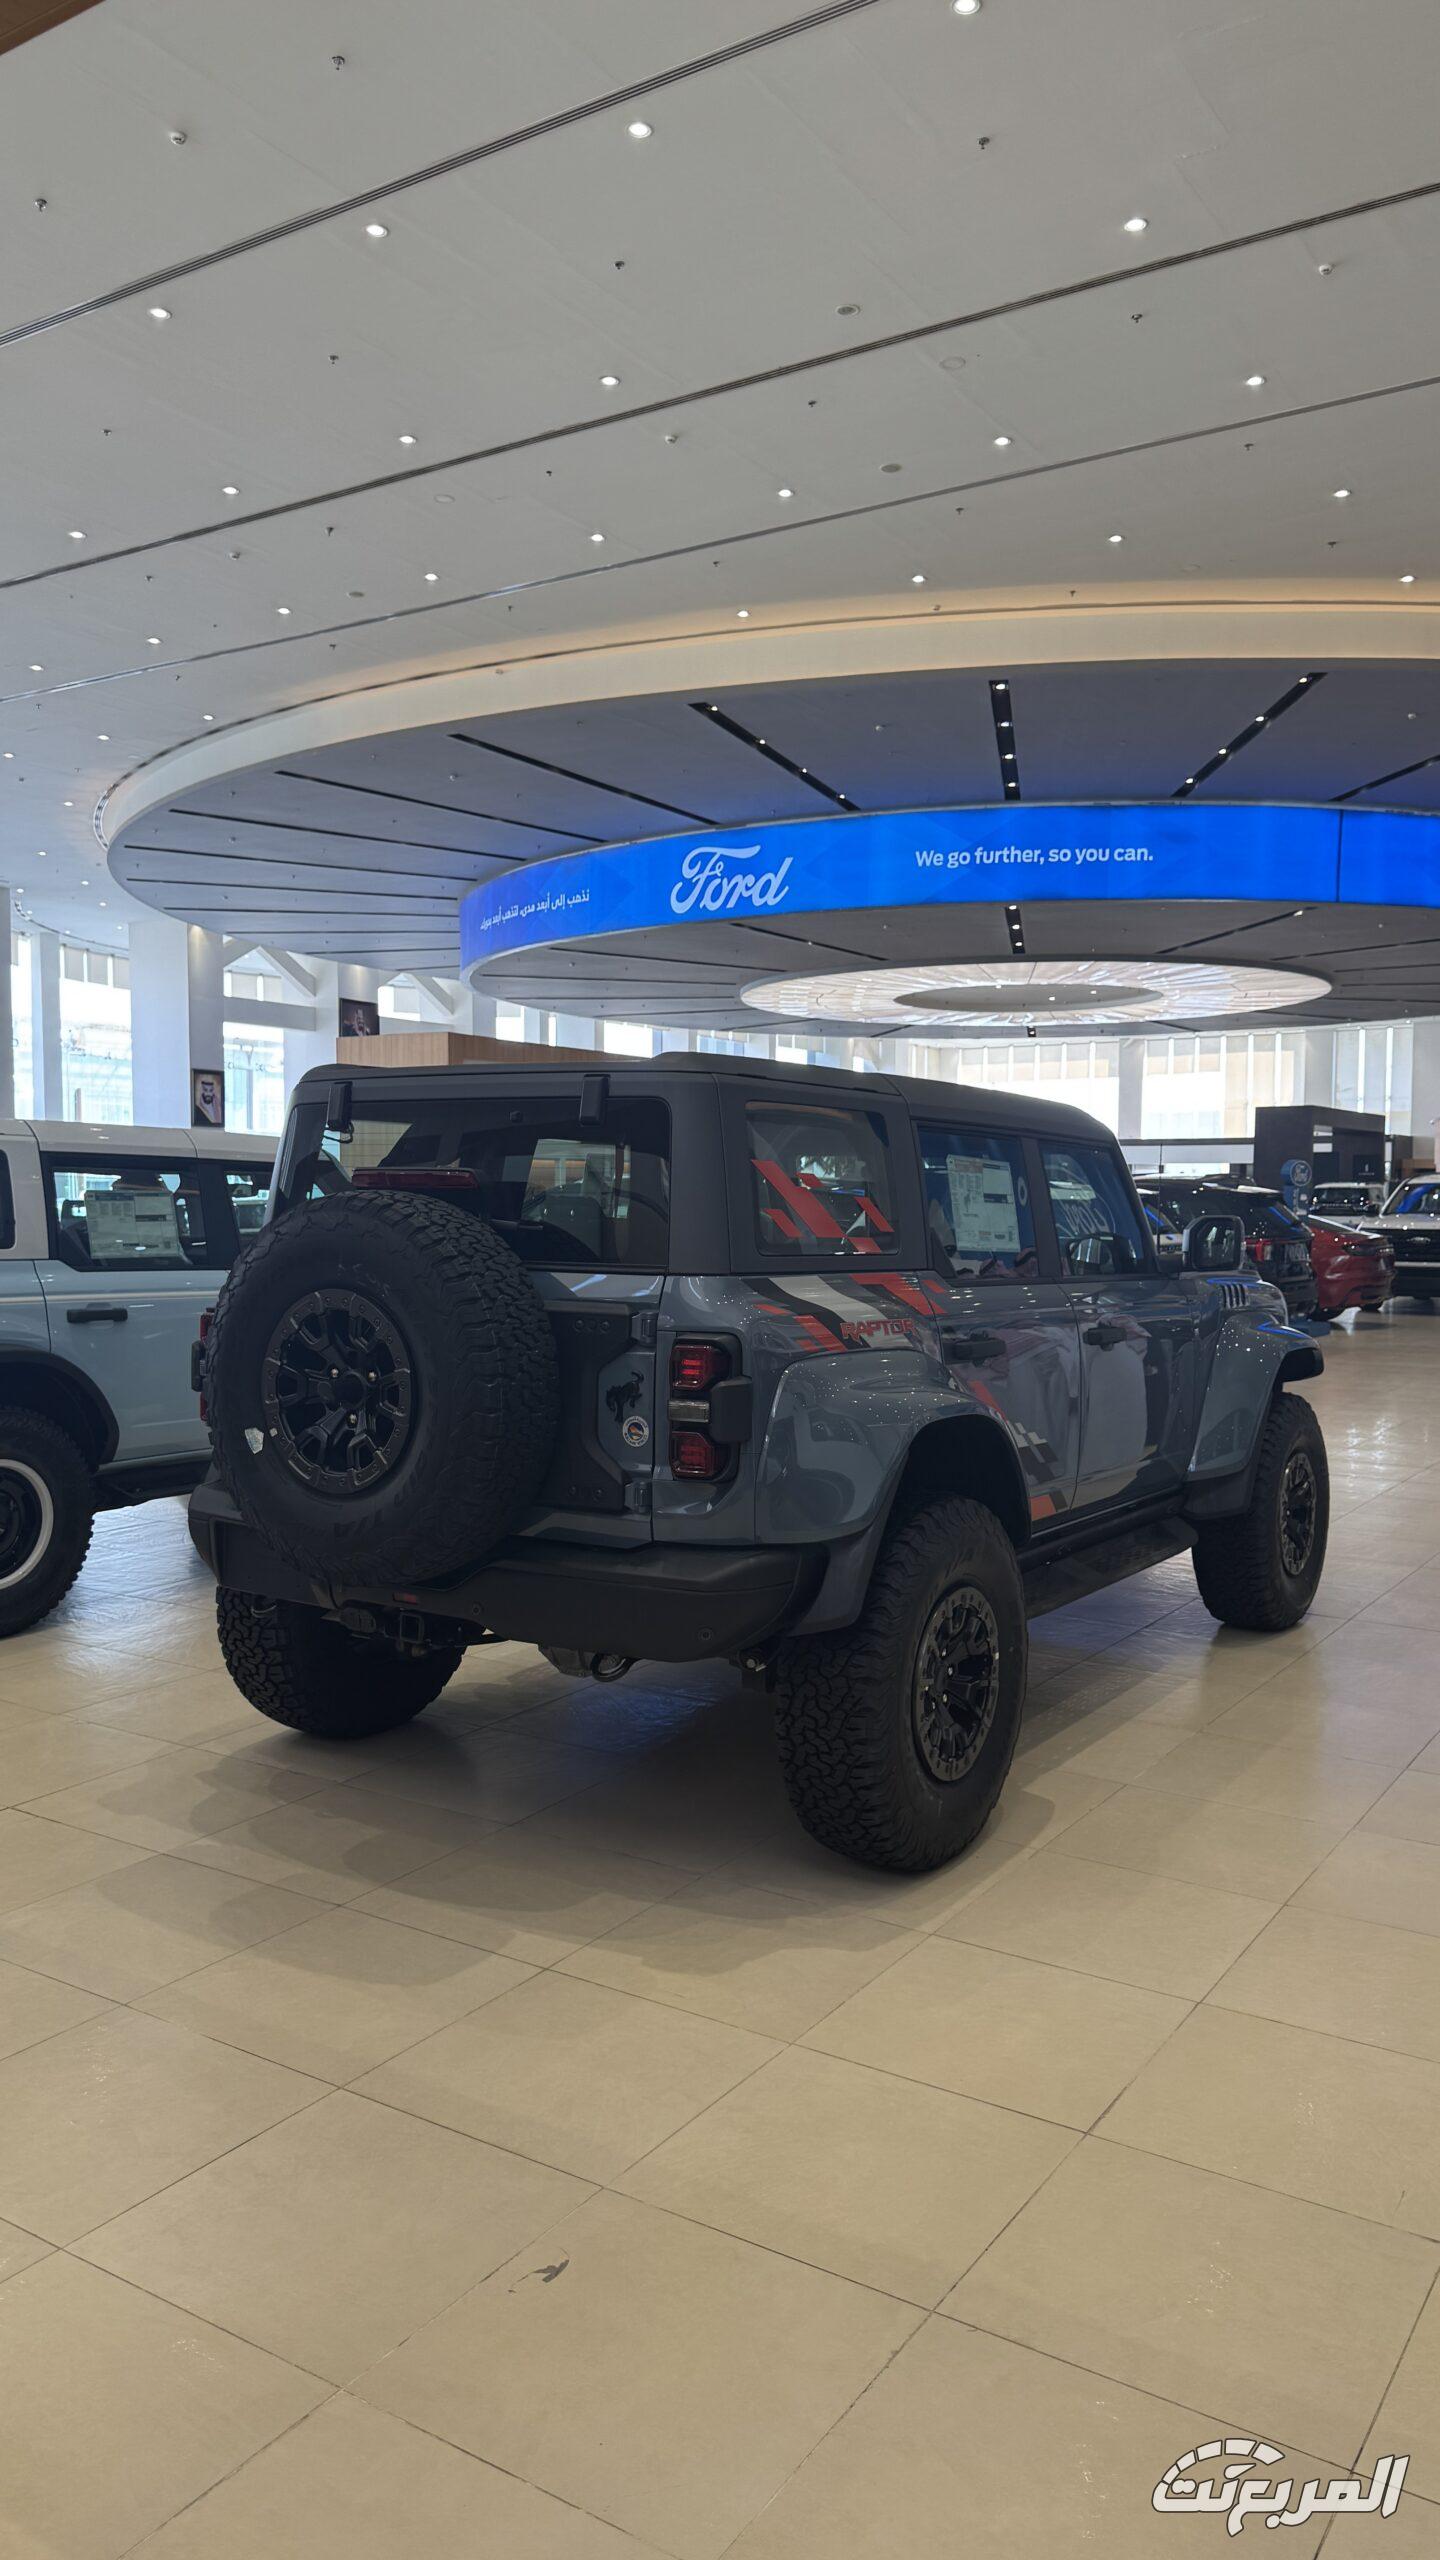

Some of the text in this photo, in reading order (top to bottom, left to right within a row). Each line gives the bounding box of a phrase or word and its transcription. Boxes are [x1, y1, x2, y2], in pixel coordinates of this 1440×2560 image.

[915, 846, 1153, 869] We go further, so you can.
[670, 845, 793, 914] Ford
[551, 893, 566, 910] إلى
[567, 888, 590, 908] نذهب
[840, 1319, 917, 1341] RAPTOR
